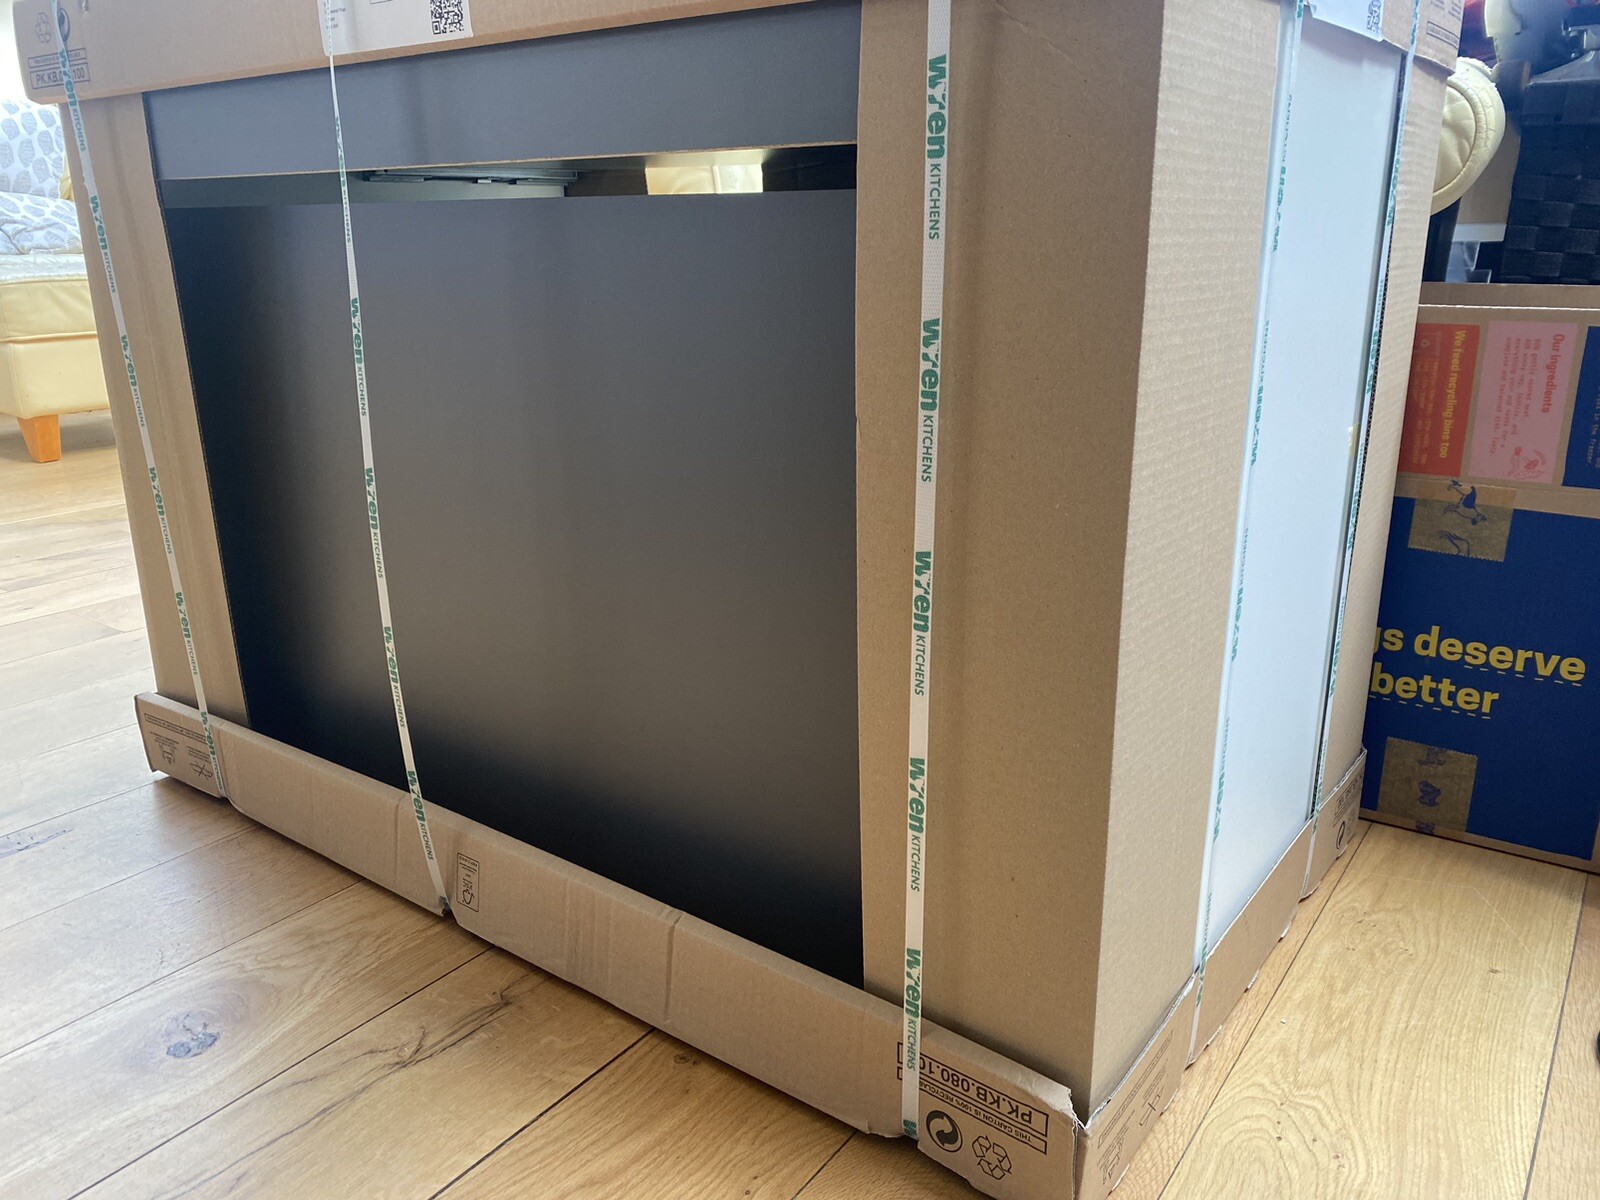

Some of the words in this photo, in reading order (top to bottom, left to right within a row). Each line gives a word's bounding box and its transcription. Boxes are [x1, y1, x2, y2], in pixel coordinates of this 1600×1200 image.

[928, 163, 941, 240] KITCHENS
[1550, 333, 1565, 352] Our
[357, 366, 367, 416] KITCHENS
[1442, 371, 1459, 418] recycling
[1541, 354, 1562, 414] ingredients
[921, 414, 934, 483] KITCHENS
[1439, 441, 1451, 459] too
[372, 532, 384, 579] KITCHENS
[914, 635, 926, 696] KITCHENS
[1414, 625, 1586, 682] deserve
[393, 685, 406, 728] KITCHENS
[1371, 662, 1500, 713] better
[420, 822, 434, 861] KITCHENS
[910, 834, 921, 892] KITCHENS
[906, 1018, 918, 1071] KITCHENS
[919, 1056, 1033, 1125] PK.KB.080.10
[919, 1080, 954, 1104] RECYCLAB
[954, 1099, 972, 1113] 100%
[974, 1109, 982, 1117] IS
[982, 1114, 1013, 1133] CARTON
[1014, 1128, 1032, 1142] THIS
